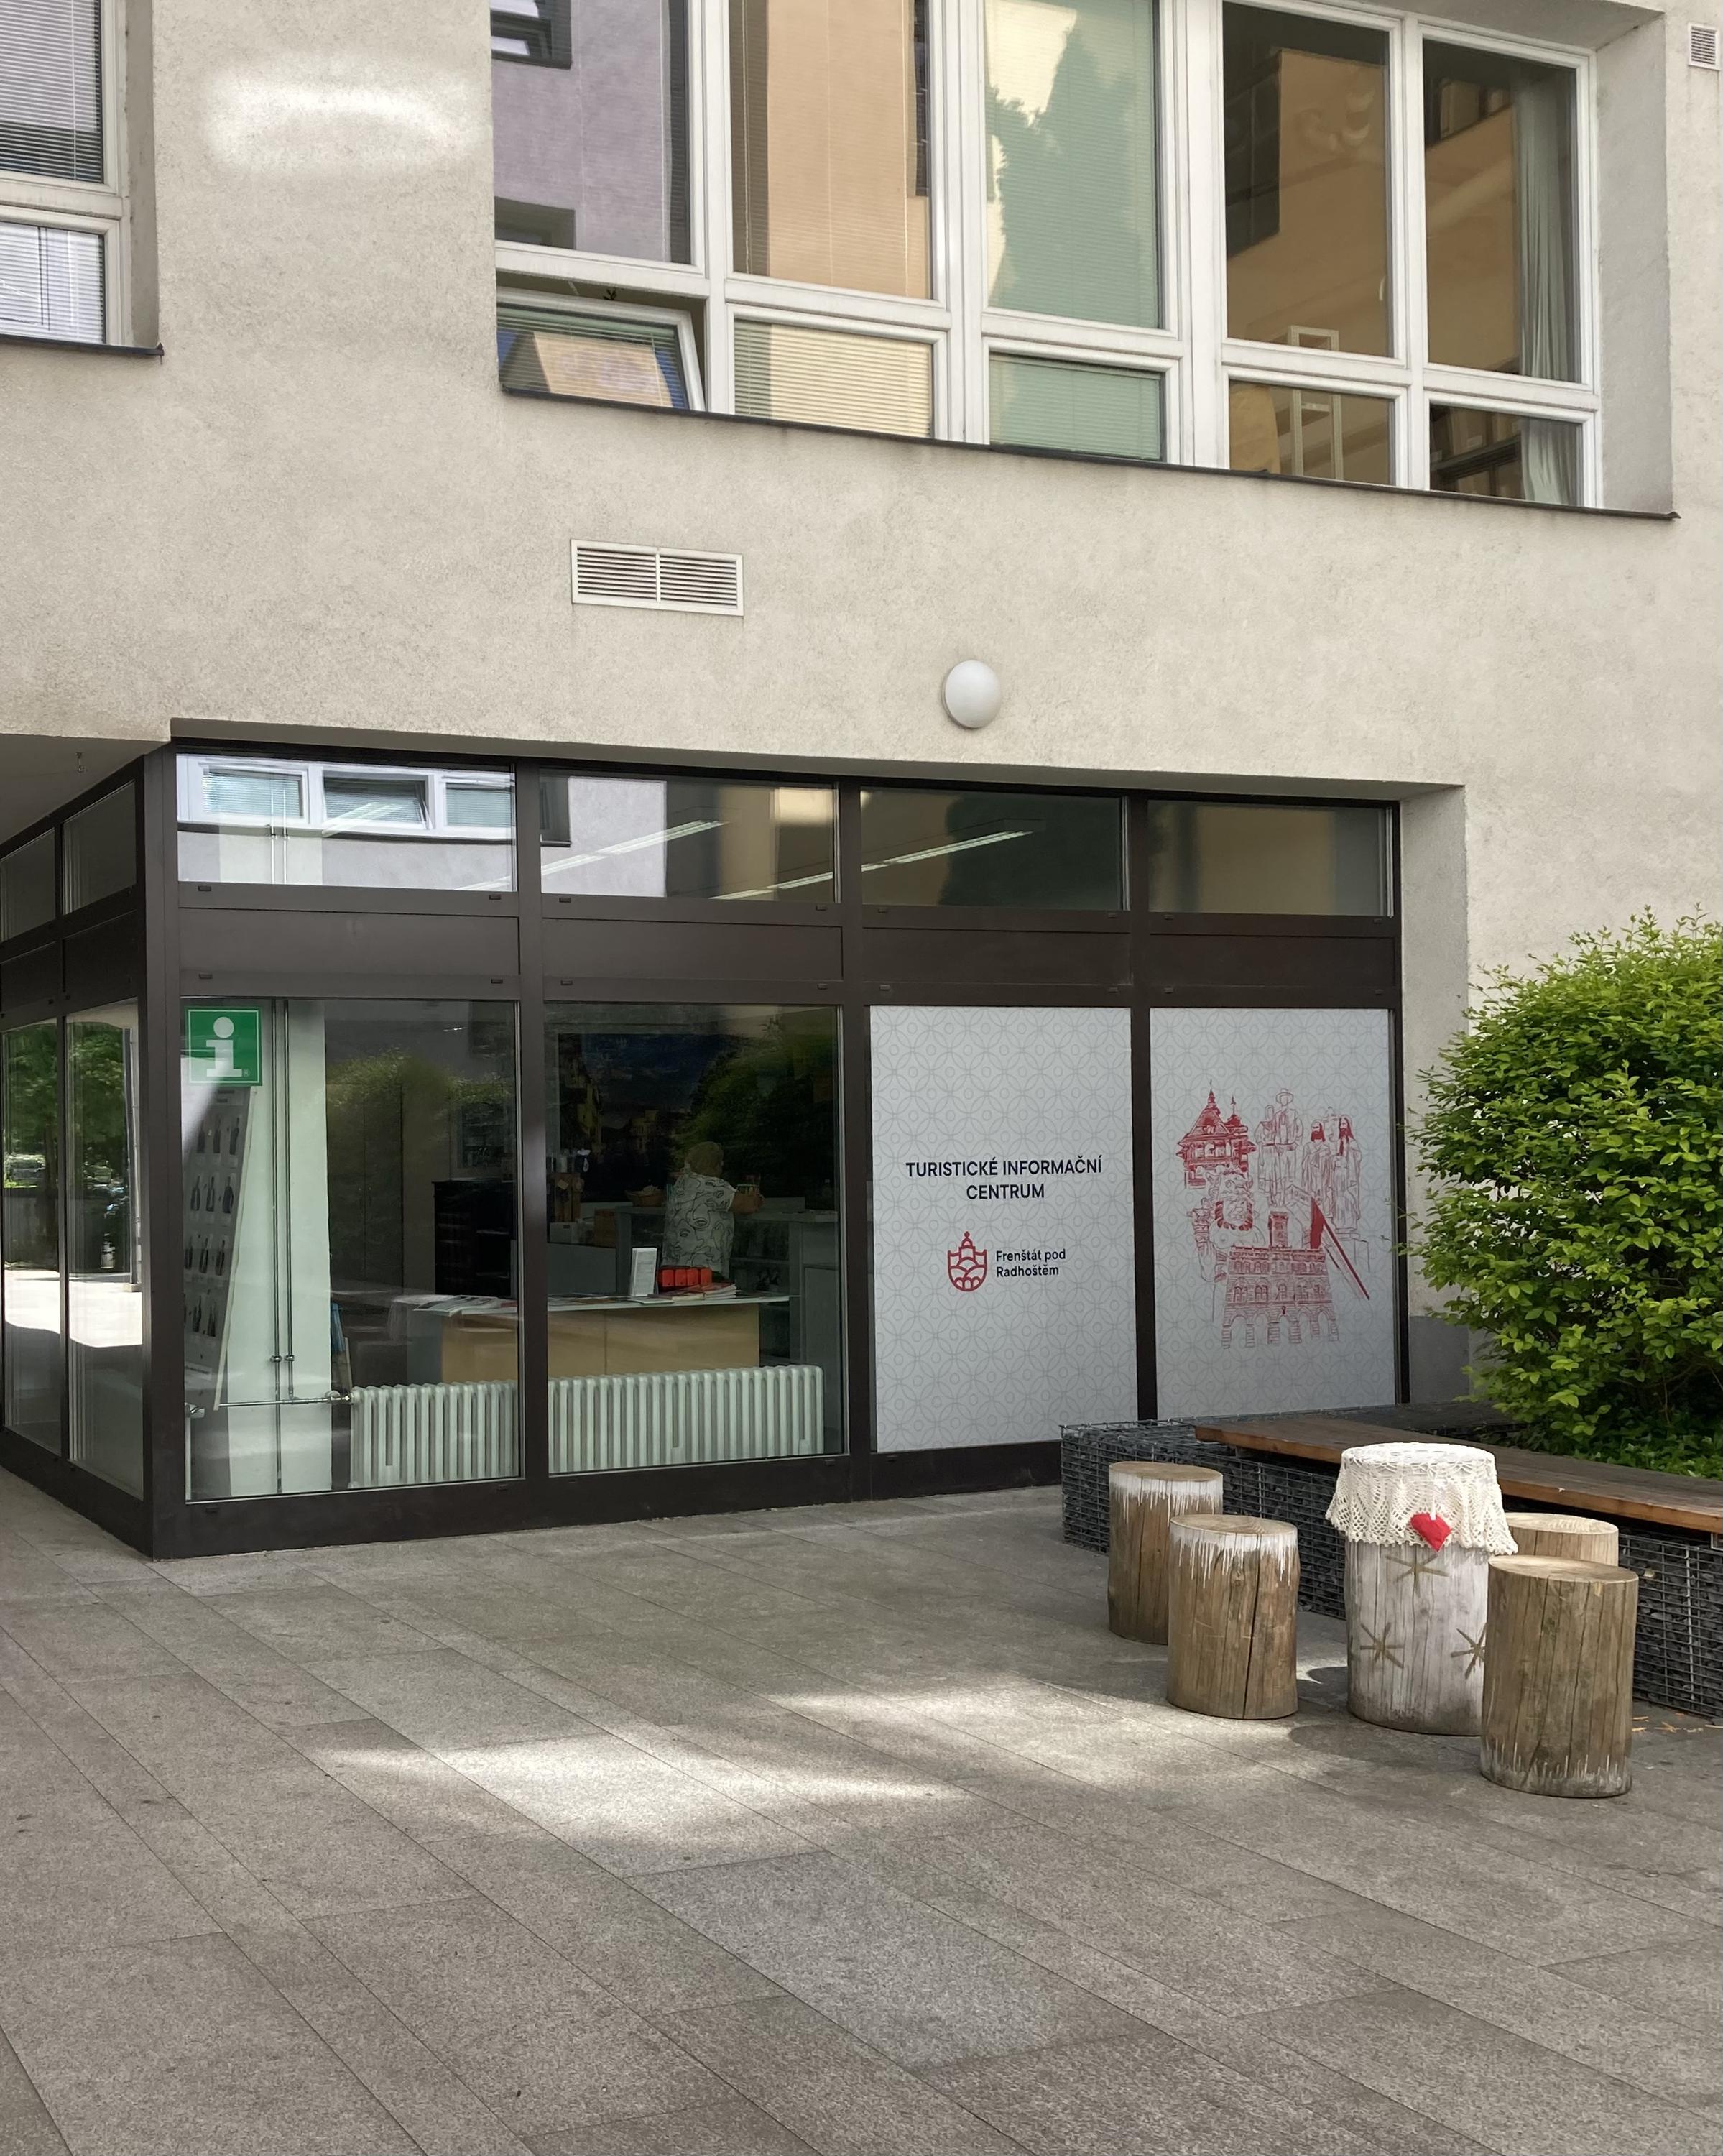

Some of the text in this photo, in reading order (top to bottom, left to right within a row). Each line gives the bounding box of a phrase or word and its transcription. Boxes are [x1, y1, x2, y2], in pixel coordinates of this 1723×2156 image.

[905, 1154, 1102, 1177] TURISTICKÉ INFORMAČNÍ
[966, 1183, 1045, 1199] CENTRUM
[996, 1248, 1066, 1262] Frenštát pod
[996, 1264, 1059, 1277] Radhoštěm
